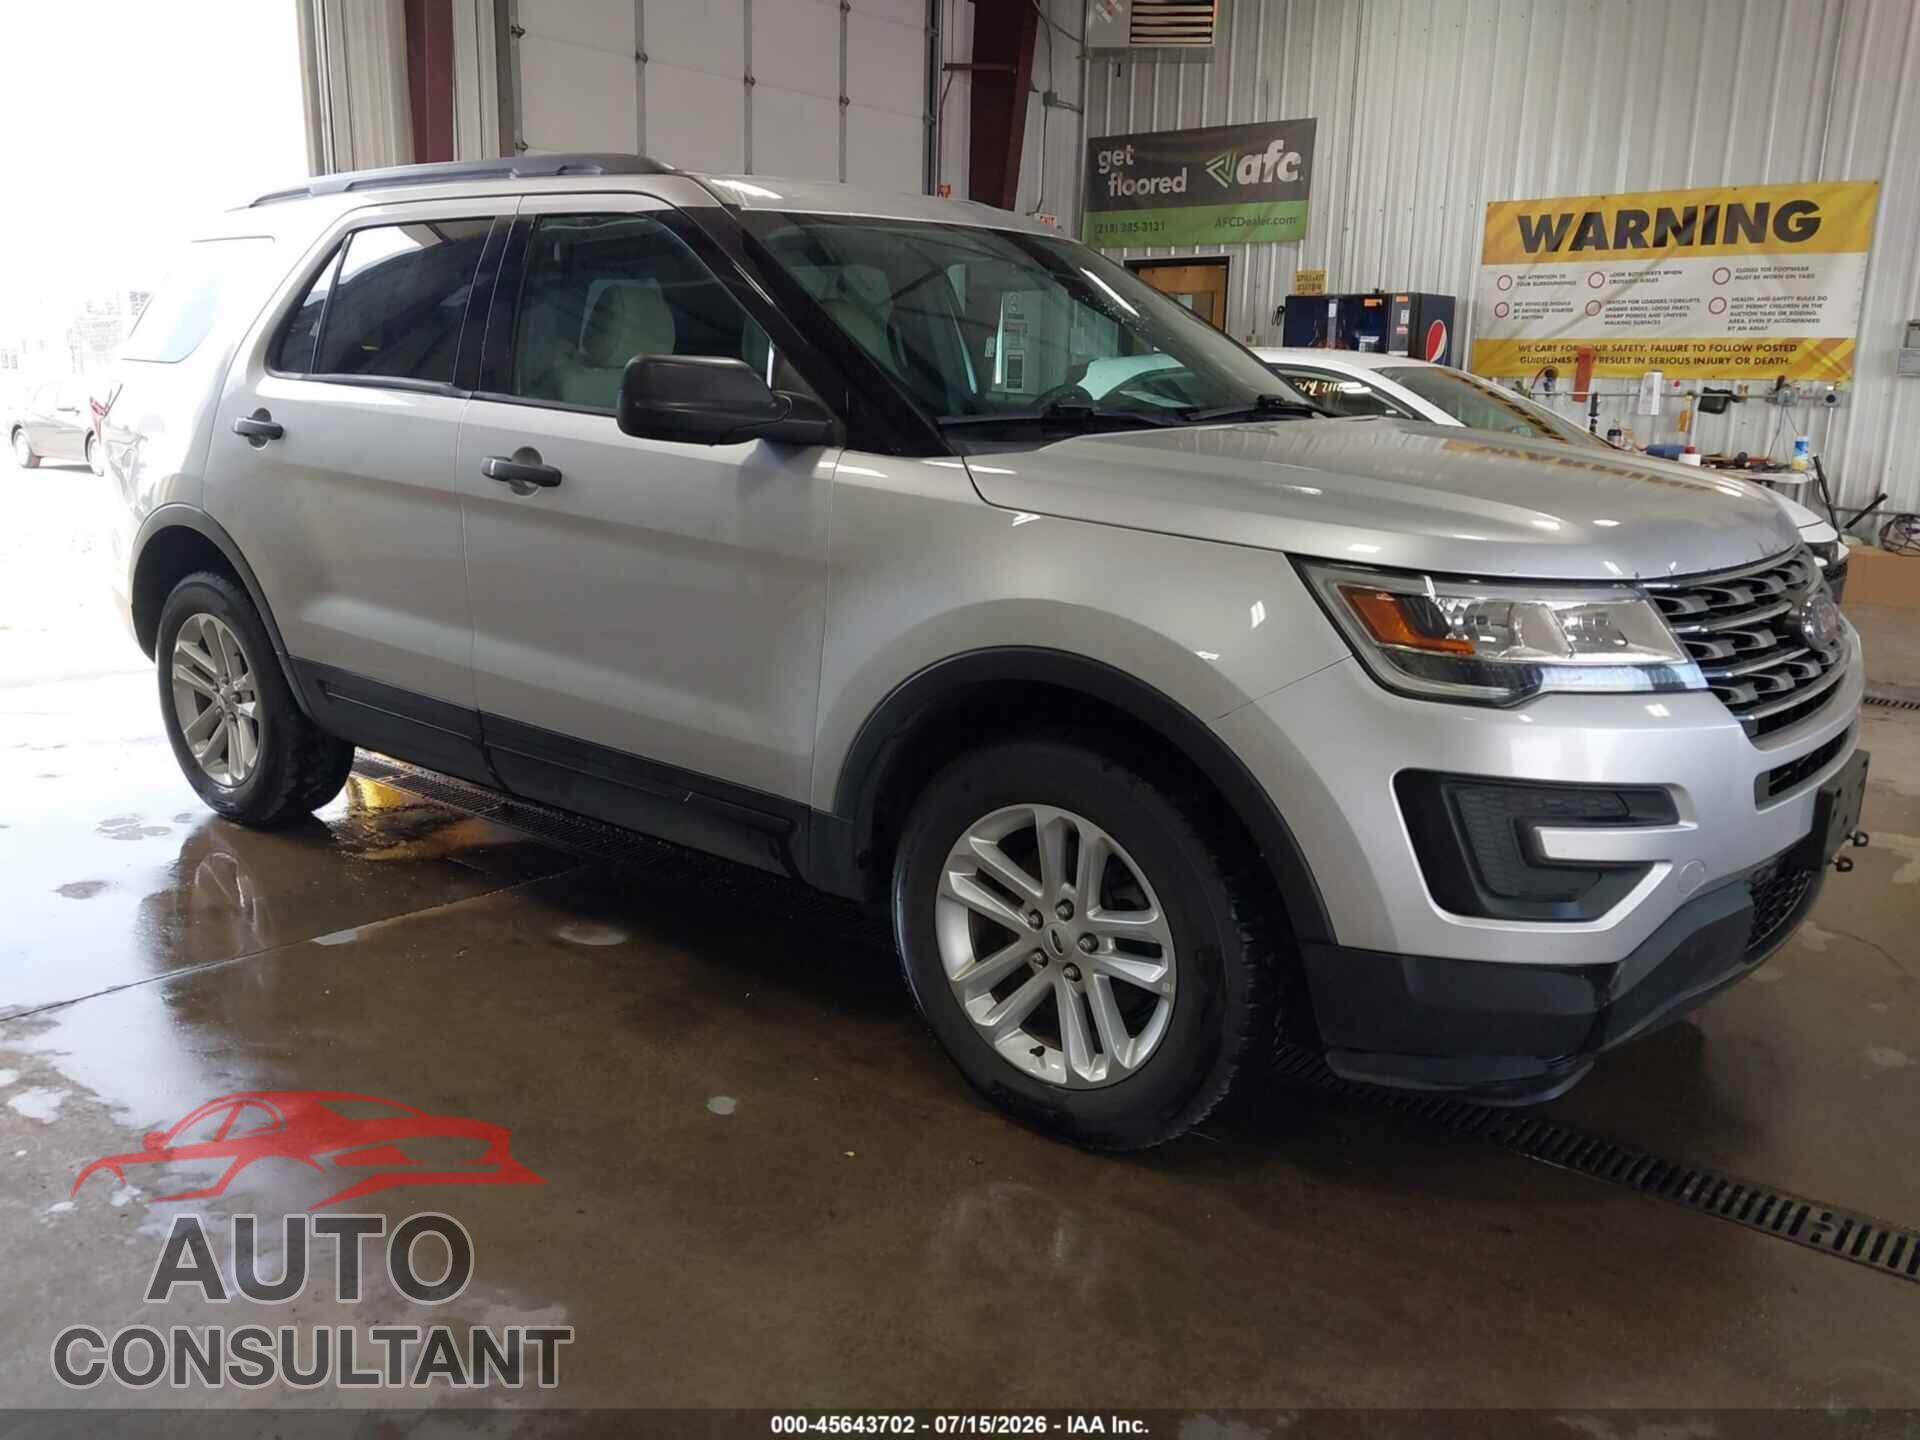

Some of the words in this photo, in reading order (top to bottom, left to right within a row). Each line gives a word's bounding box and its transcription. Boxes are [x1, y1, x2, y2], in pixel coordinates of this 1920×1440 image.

[1098, 144, 1135, 175] get
[1236, 139, 1303, 185] afc
[1107, 167, 1188, 197] floored
[1517, 199, 1823, 254] WARNING
[1519, 344, 1533, 352] WE
[1535, 344, 1558, 353] CARE
[1650, 344, 1689, 352] FAILURE
[1693, 344, 1706, 352] TO
[1709, 344, 1753, 352] FOLLOW
[1756, 343, 1797, 352] POSTED
[1520, 356, 1572, 365] GUIDELINES
[1599, 356, 1631, 365] RESULT
[1634, 356, 1646, 365] IN
[1648, 356, 1690, 365] SERIOUS
[1694, 356, 1731, 365] INJURY
[1735, 356, 1751, 365] OR
